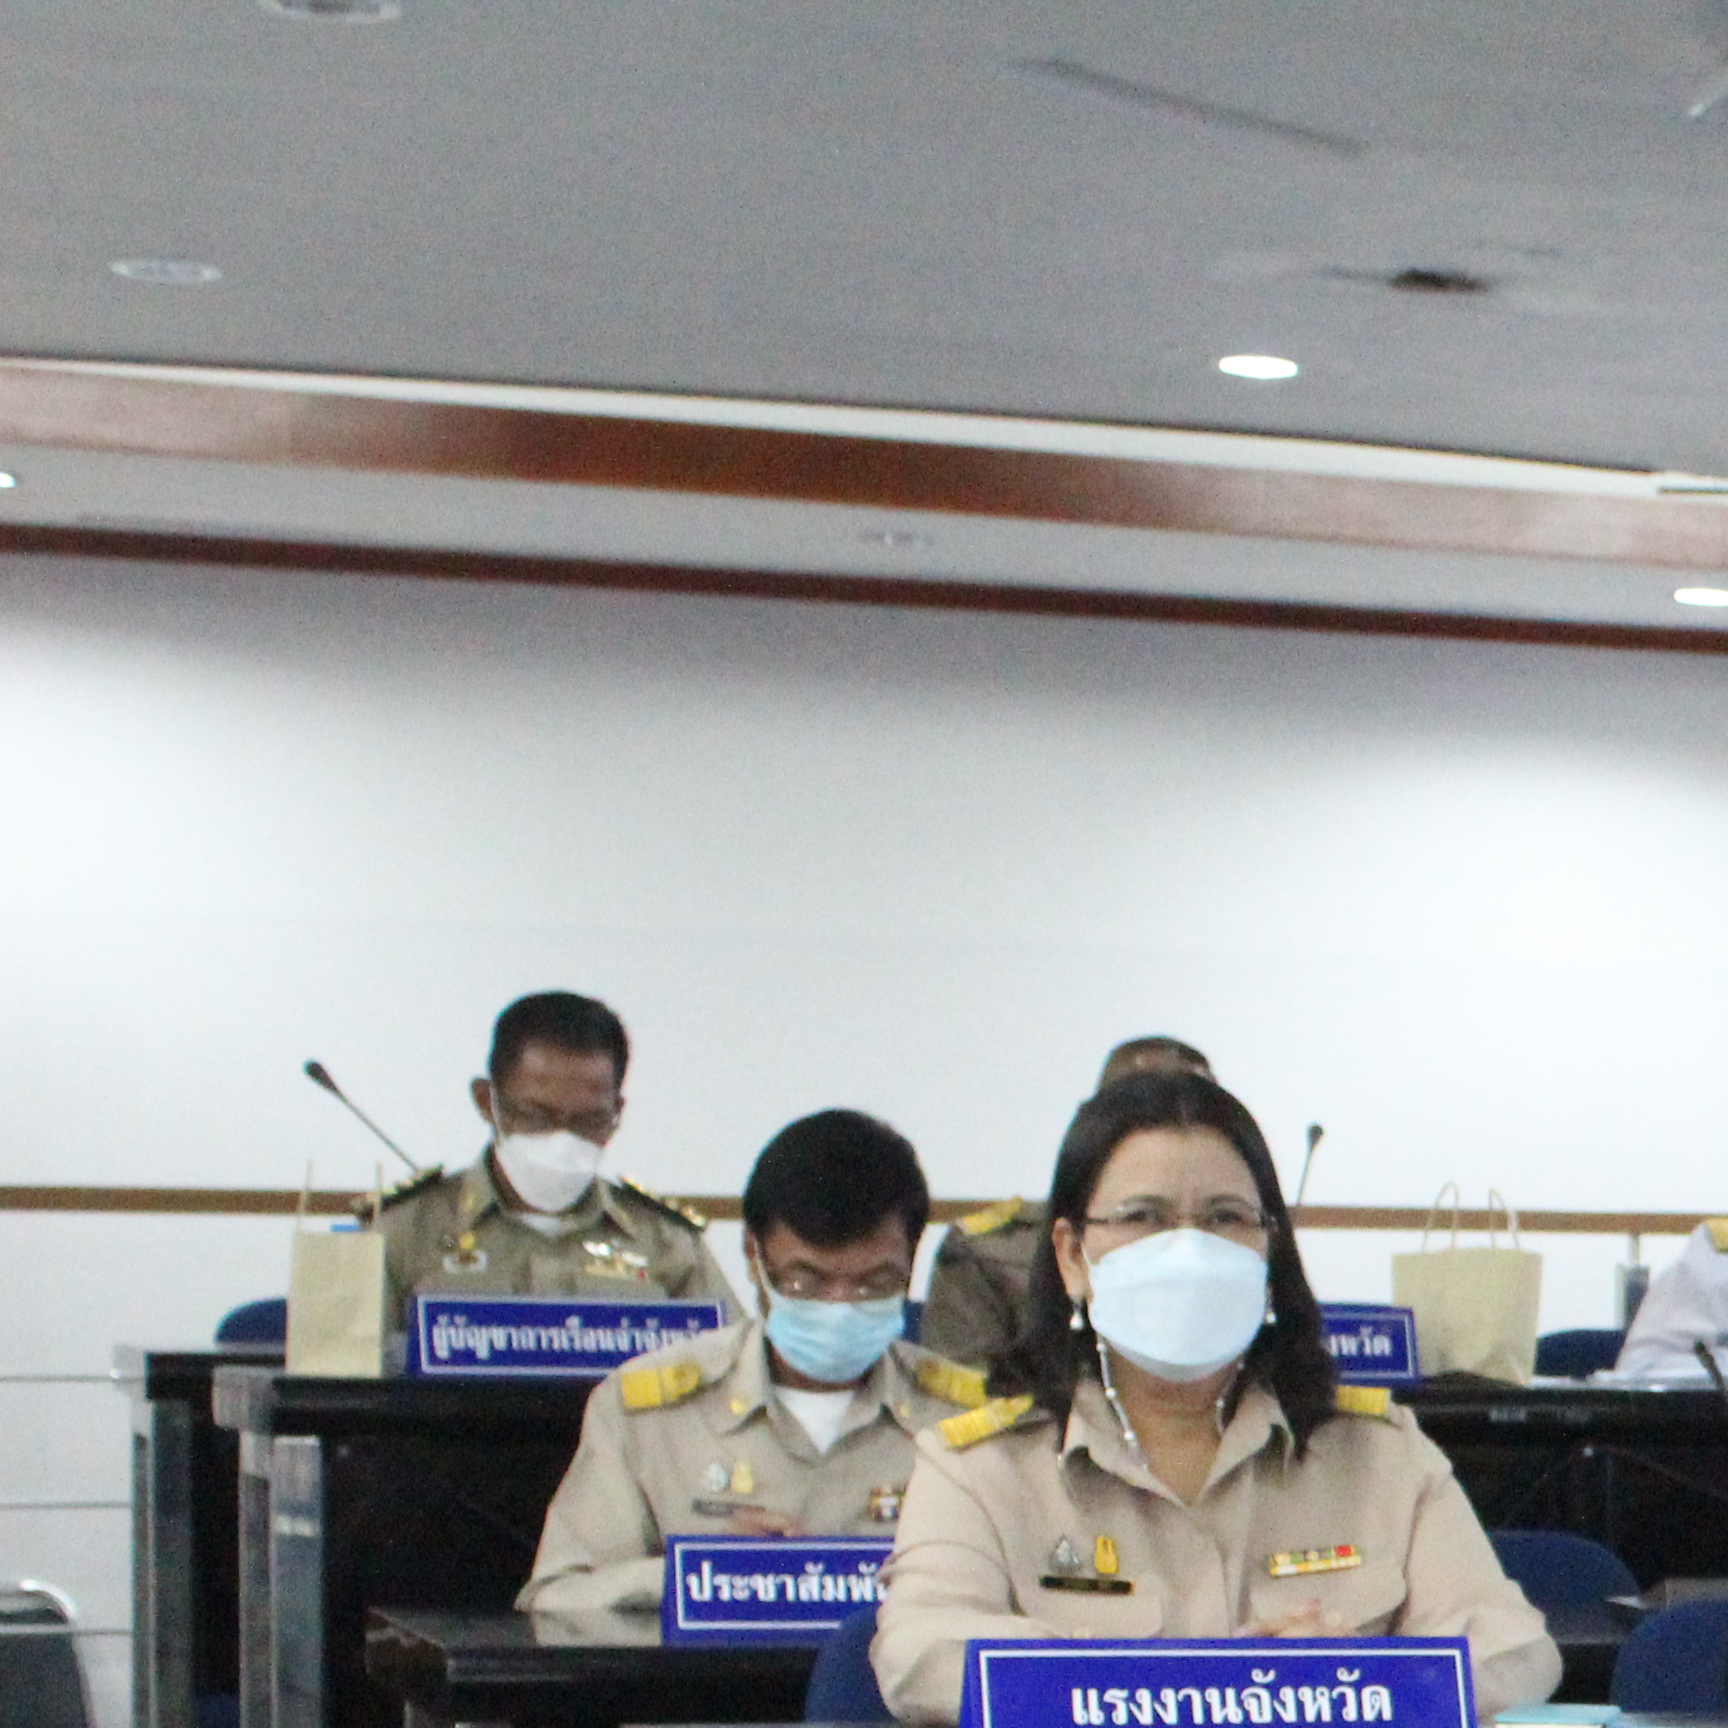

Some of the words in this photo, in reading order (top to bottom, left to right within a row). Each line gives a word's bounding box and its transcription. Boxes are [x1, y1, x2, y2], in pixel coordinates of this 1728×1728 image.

[433, 1314, 699, 1360] ผู้บัญชาการเรือนจำจังั
[1070, 1667, 1393, 1726] แรงงานจังหวัด
